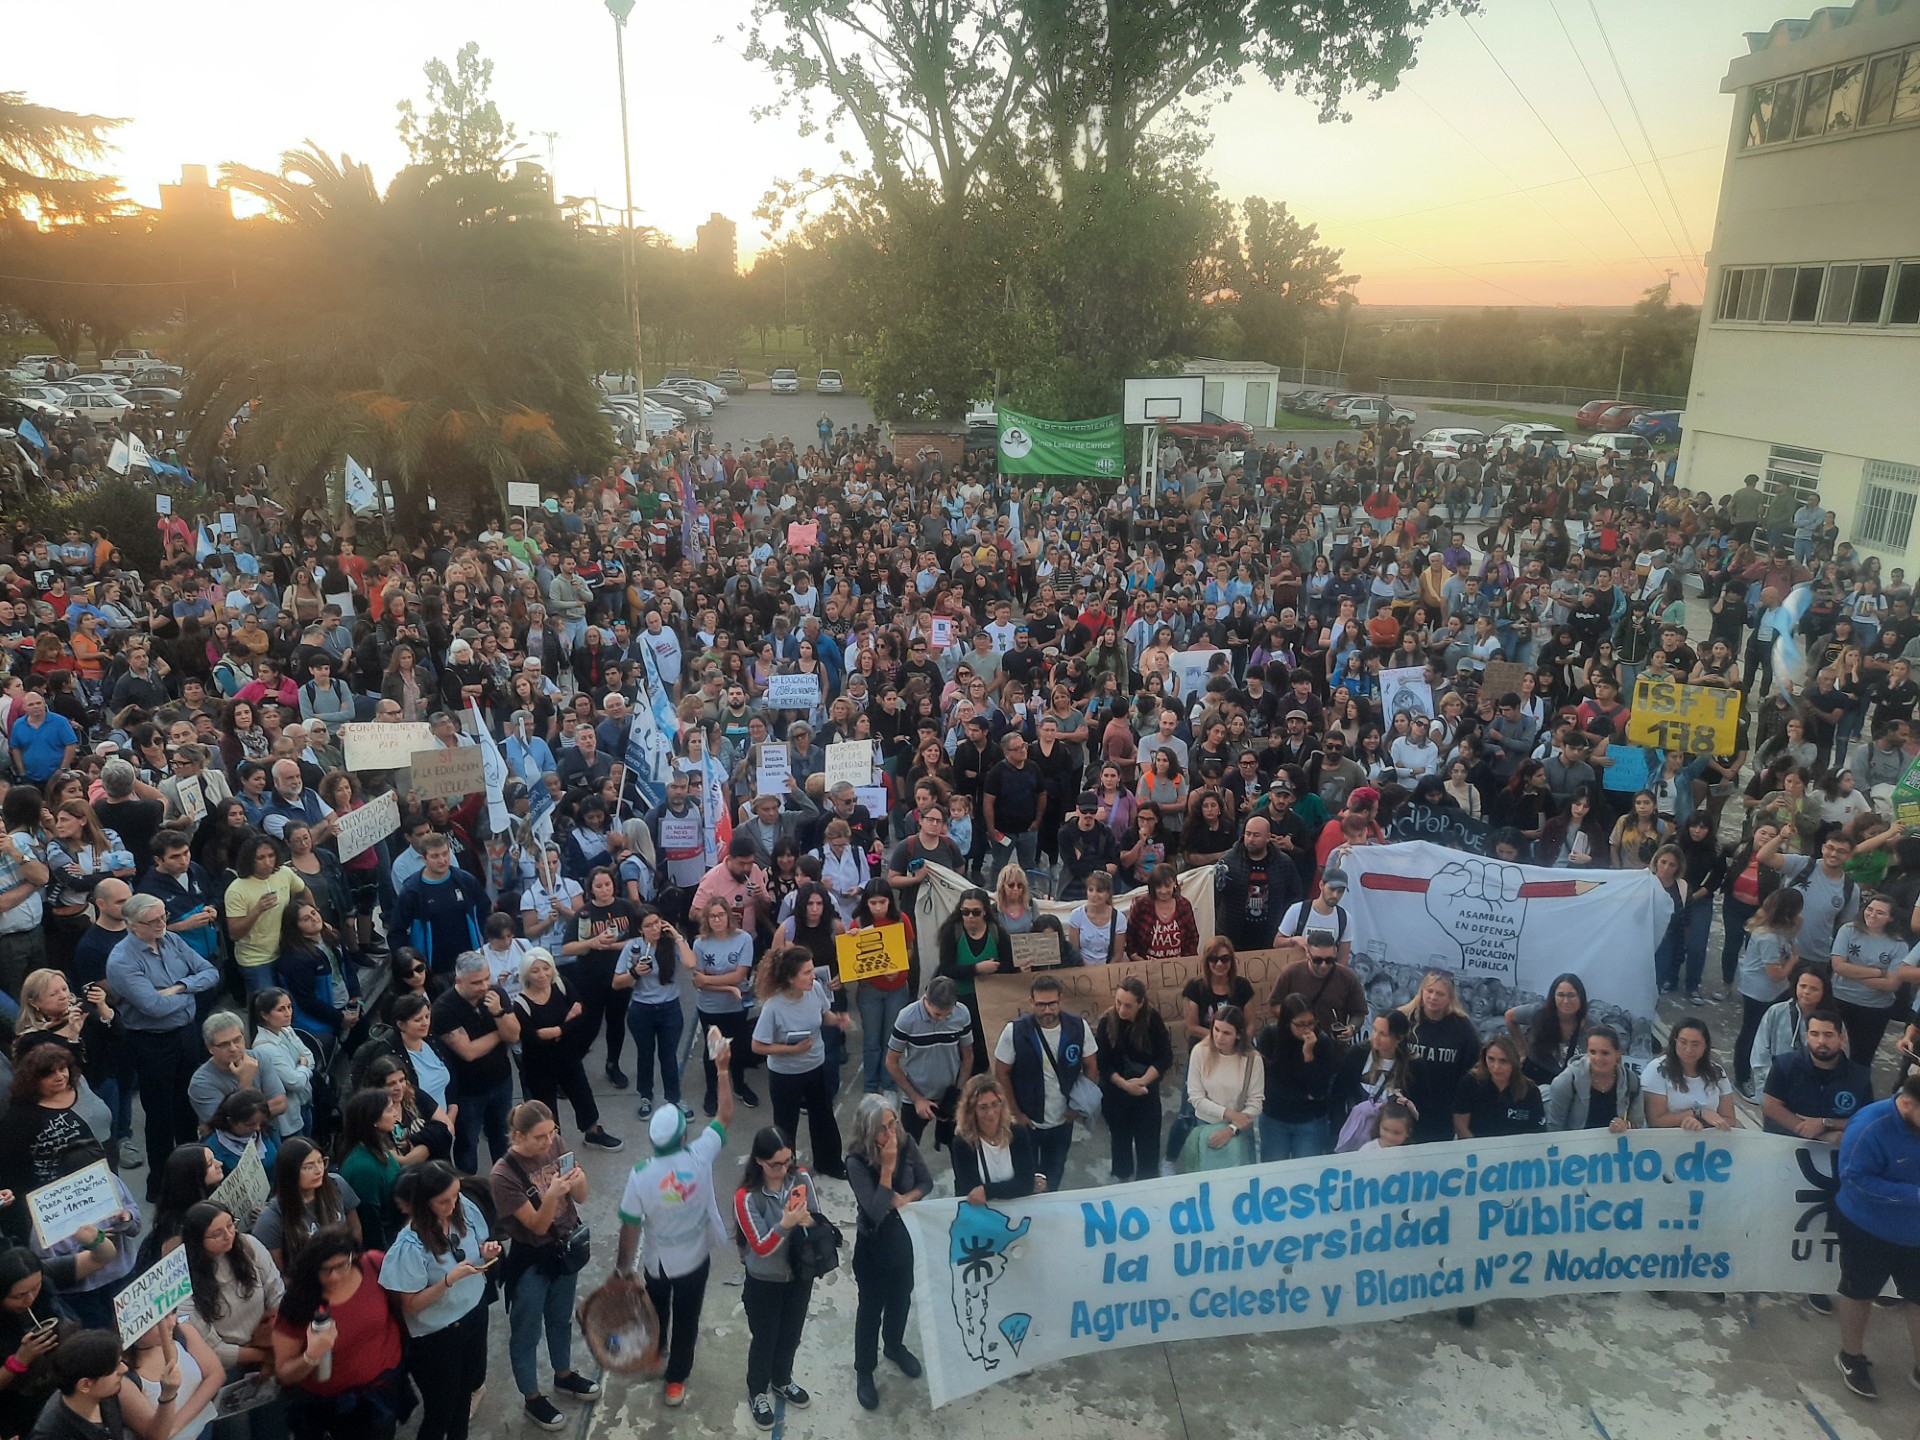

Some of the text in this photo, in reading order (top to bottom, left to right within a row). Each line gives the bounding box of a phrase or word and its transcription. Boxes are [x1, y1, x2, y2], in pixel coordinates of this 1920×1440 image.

[1456, 921, 1516, 937] EN DEFENSA
[1459, 910, 1514, 924] ASAMBLEA
[1465, 946, 1515, 960] EDUCACIÓN
[1481, 939, 1492, 947] DE
[1468, 958, 1509, 971] PÚBLICA
[1427, 1048, 1435, 1061] A
[1438, 1047, 1457, 1062] TOY
[39, 1198, 62, 1212] PLAZA
[72, 1176, 108, 1197] TENEMOS
[44, 1185, 72, 1200] CAPUTO
[73, 1179, 83, 1188] EN
[84, 1175, 94, 1184] LA
[1081, 1136, 1733, 1247] No al desfinanciamiento de
[43, 1196, 96, 1224] QUE MATAR
[1103, 1252, 1148, 1284] la
[1174, 1206, 1450, 1277] Universidad
[1479, 1194, 1643, 1240] Pública
[115, 1291, 131, 1313] NO
[132, 1266, 163, 1299] FALTAN
[1070, 1299, 1179, 1342] Agrup.
[1189, 1279, 1310, 1318] Celeste
[1321, 1284, 1341, 1317] y
[1356, 1267, 1463, 1307] Blanca
[1545, 1245, 1730, 1281] Nodocentes
